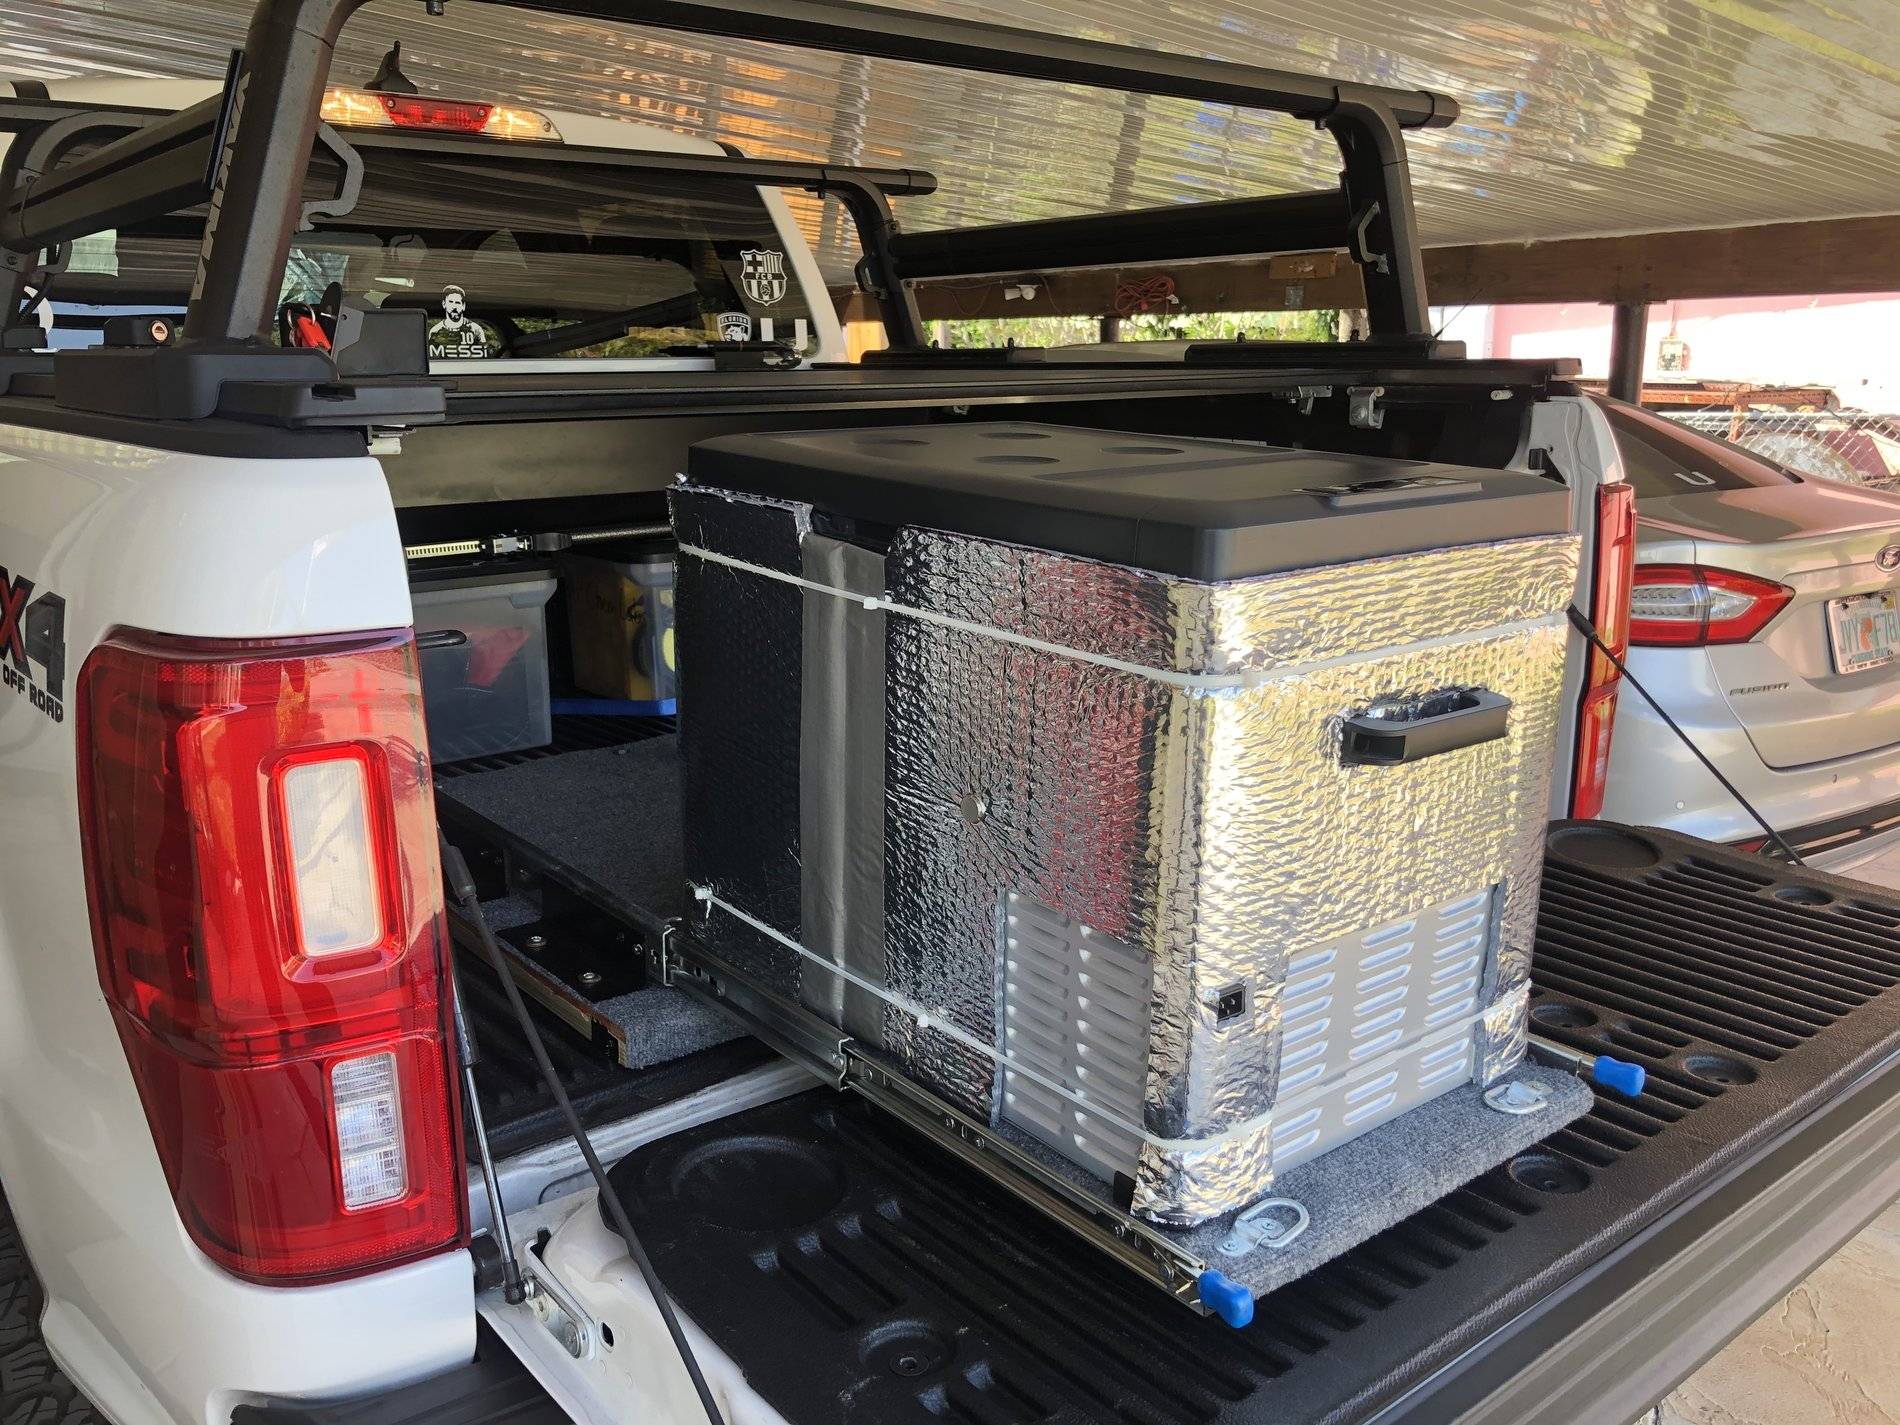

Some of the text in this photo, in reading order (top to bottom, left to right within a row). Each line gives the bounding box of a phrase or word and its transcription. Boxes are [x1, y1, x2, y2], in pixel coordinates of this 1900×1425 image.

[190, 72, 251, 300] YAKIMA
[460, 331, 475, 344] 10
[2, 663, 64, 724] OFF ROAD
